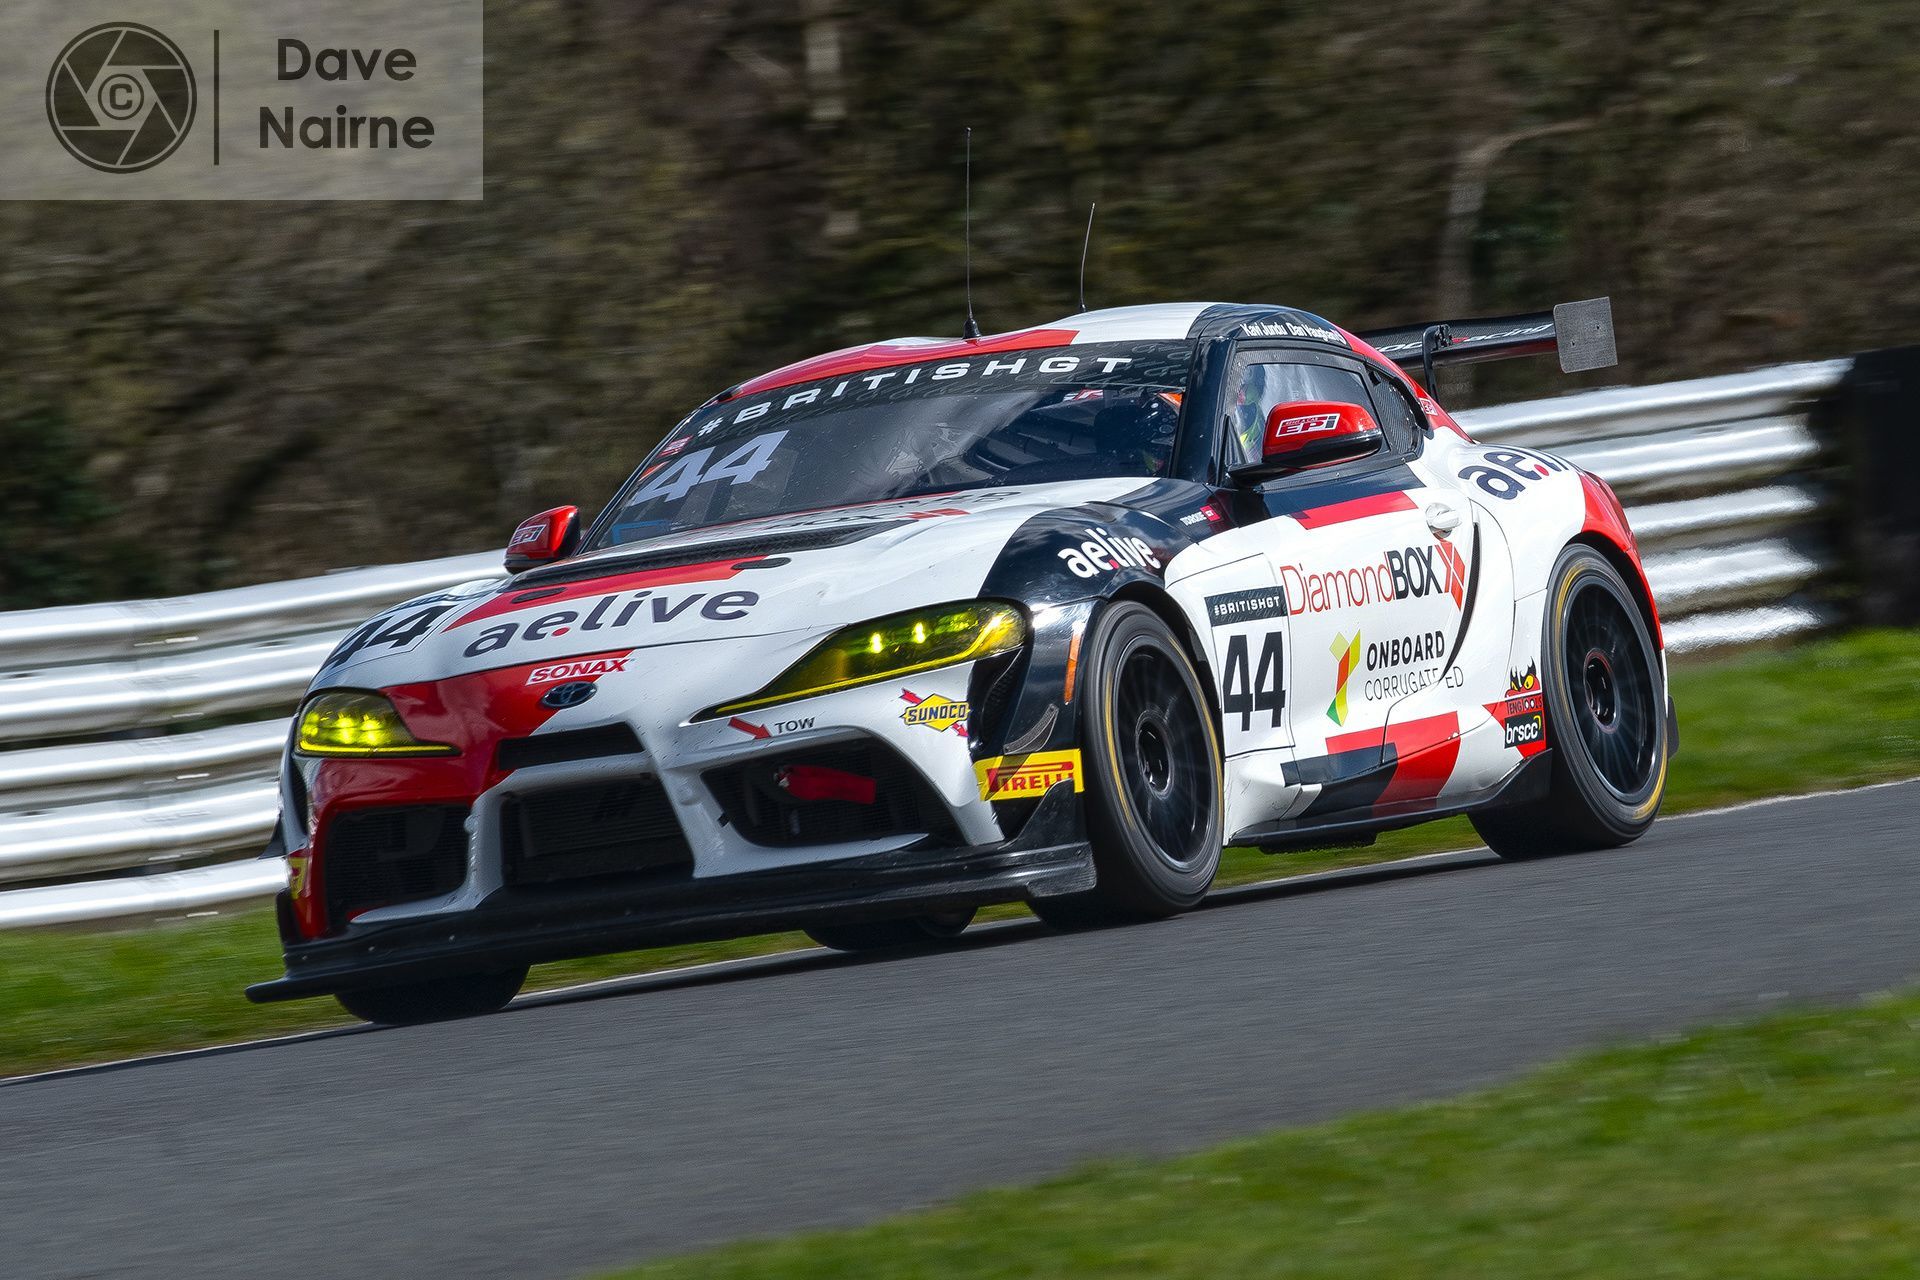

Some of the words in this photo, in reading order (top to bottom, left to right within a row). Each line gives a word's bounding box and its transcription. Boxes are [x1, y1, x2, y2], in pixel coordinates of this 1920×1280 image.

[1286, 322, 1308, 337] Dan
[627, 430, 789, 507] 44
[1280, 545, 1443, 616] DiamondBOX
[319, 604, 459, 670] 44
[1366, 630, 1445, 672] ONBOARD
[530, 658, 629, 683] SONAX
[1222, 631, 1286, 732] 44
[775, 716, 815, 734] TOW
[907, 703, 968, 722] SUNOCO
[1506, 722, 1539, 744] brscc
